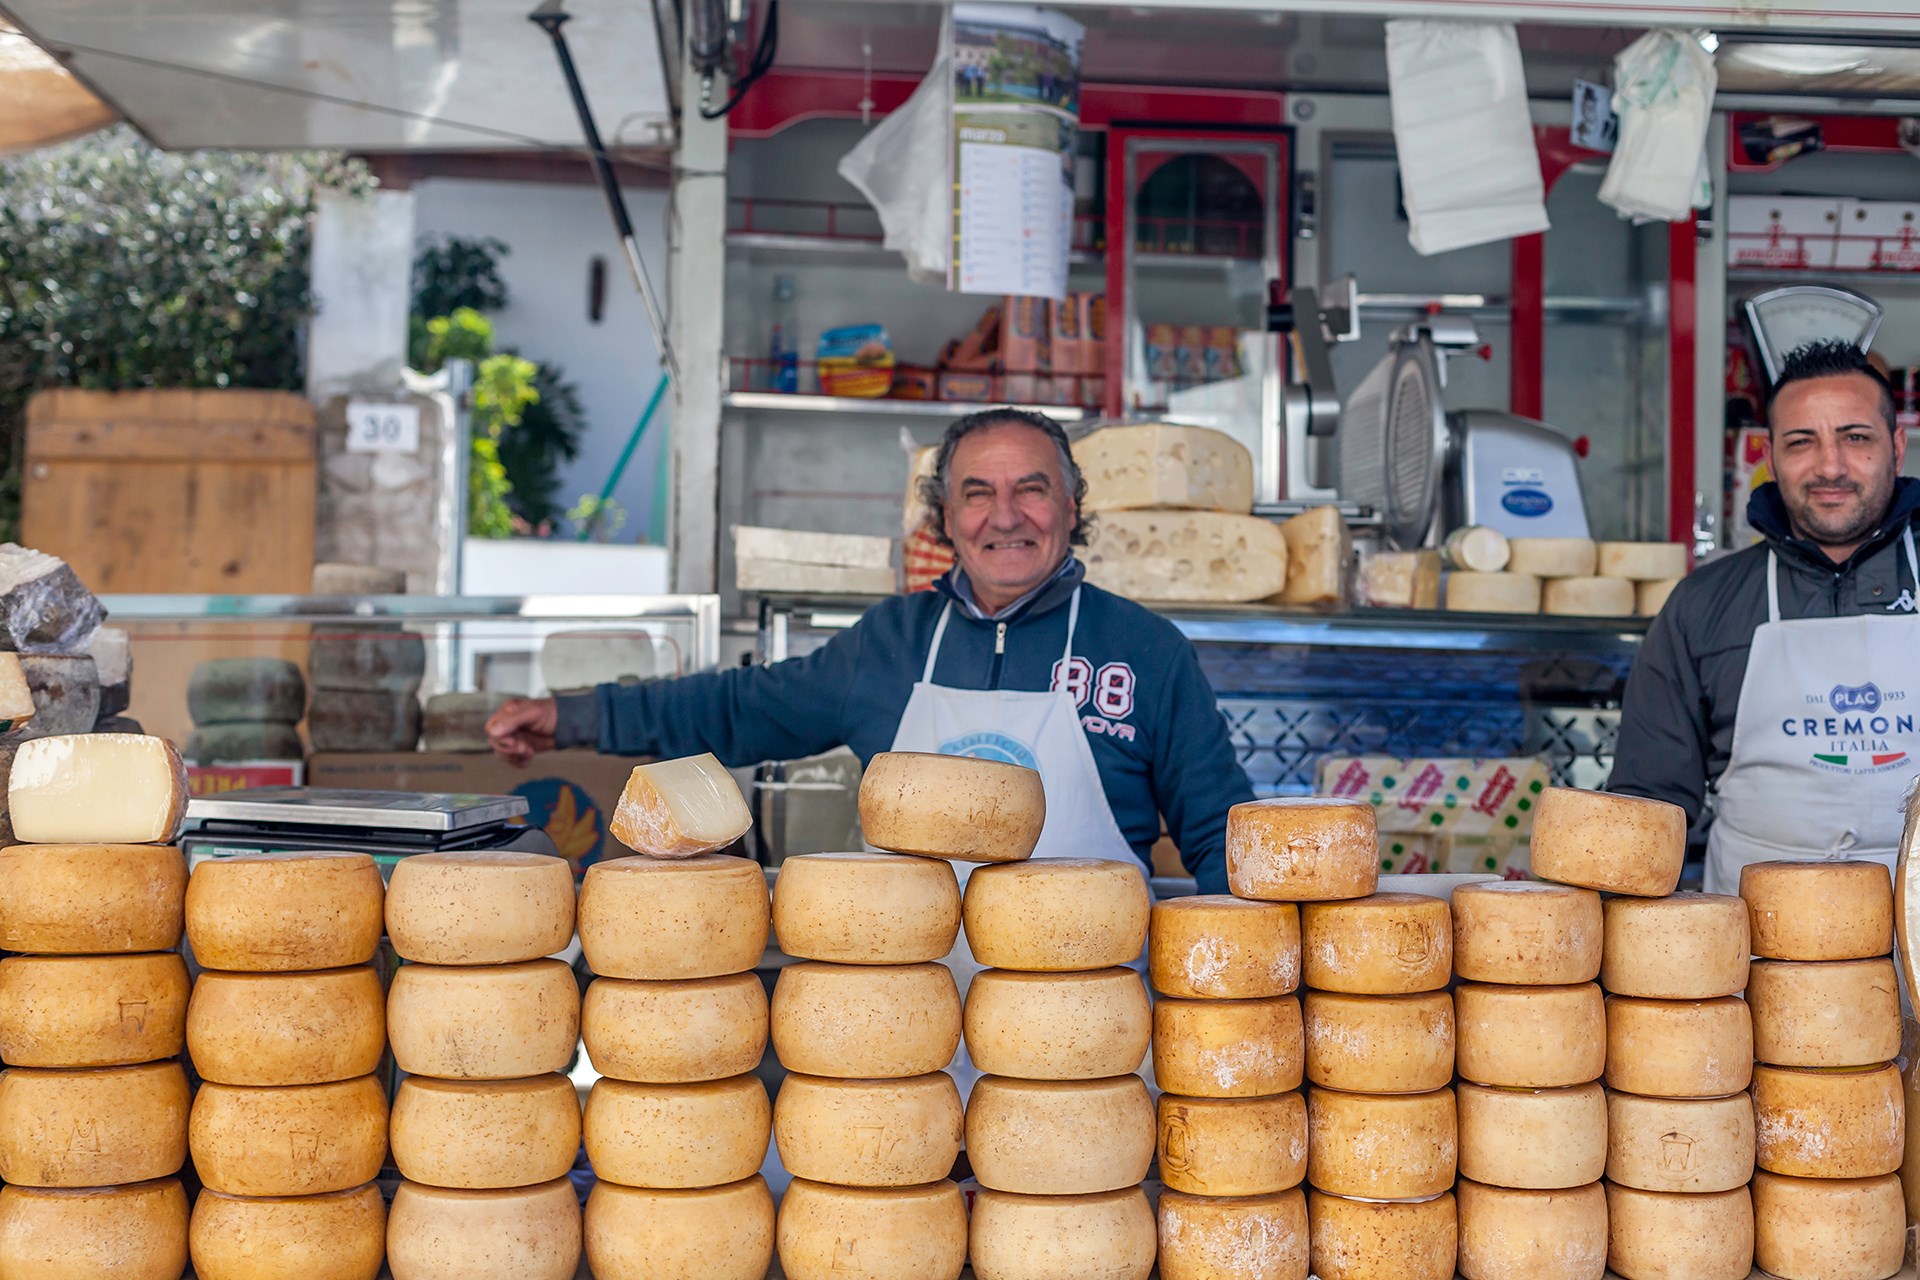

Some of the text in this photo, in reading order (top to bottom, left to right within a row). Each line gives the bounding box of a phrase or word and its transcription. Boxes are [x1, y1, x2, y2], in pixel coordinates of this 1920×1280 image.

[362, 413, 401, 445] 30
[1049, 656, 1136, 720] 88
[1834, 690, 1877, 706] PLAC
[1883, 690, 1906, 702] 1933
[1782, 714, 1920, 737] CREMON
[1830, 739, 1889, 752] ITALIA
